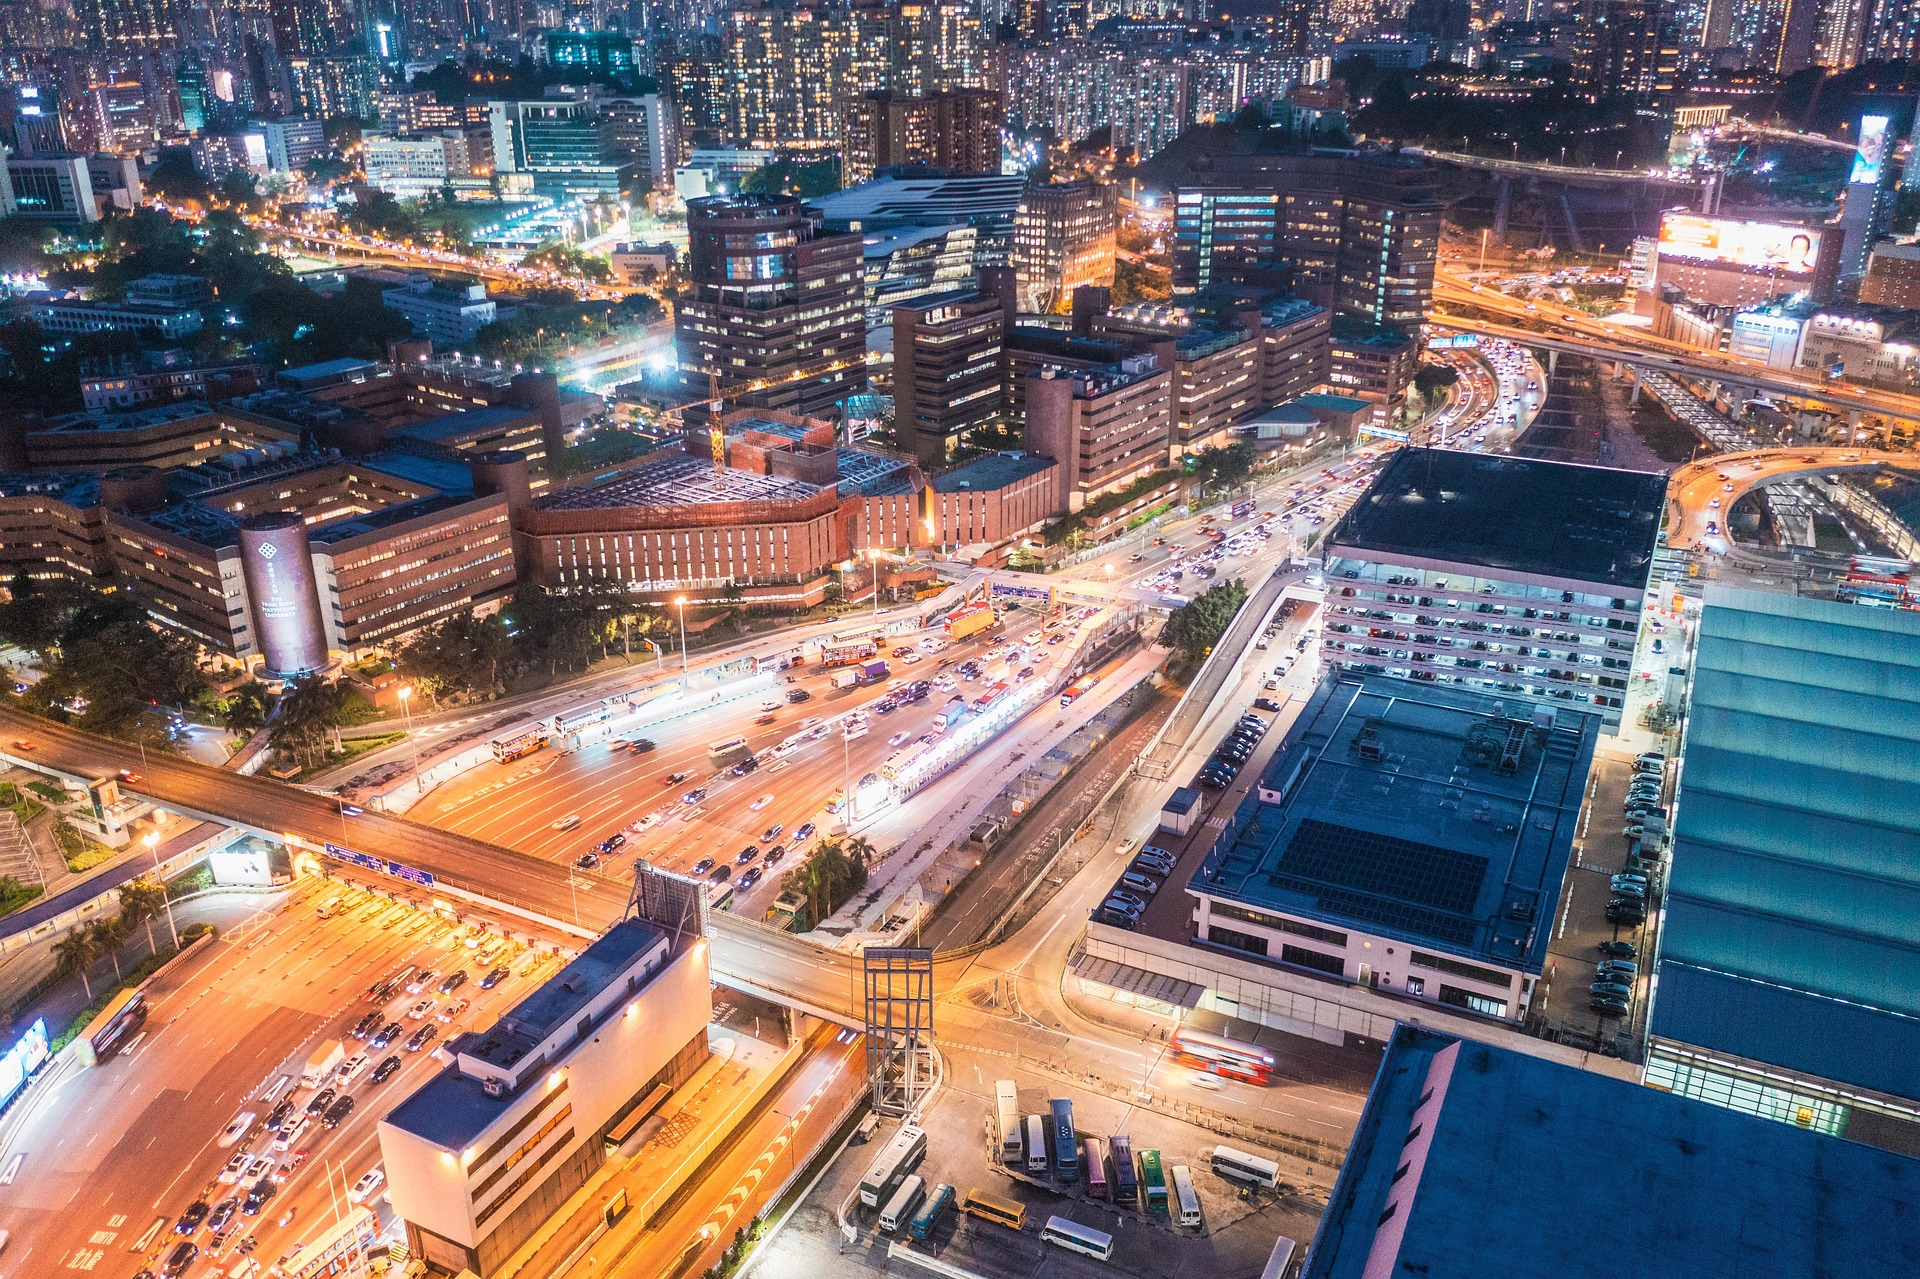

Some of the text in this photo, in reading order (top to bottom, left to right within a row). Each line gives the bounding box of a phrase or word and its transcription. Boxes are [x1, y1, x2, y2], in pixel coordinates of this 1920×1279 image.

[262, 605, 298, 613] POLYTECHNIC
[88, 1231, 119, 1245] NORTH
[66, 1248, 105, 1271] 北九龍
